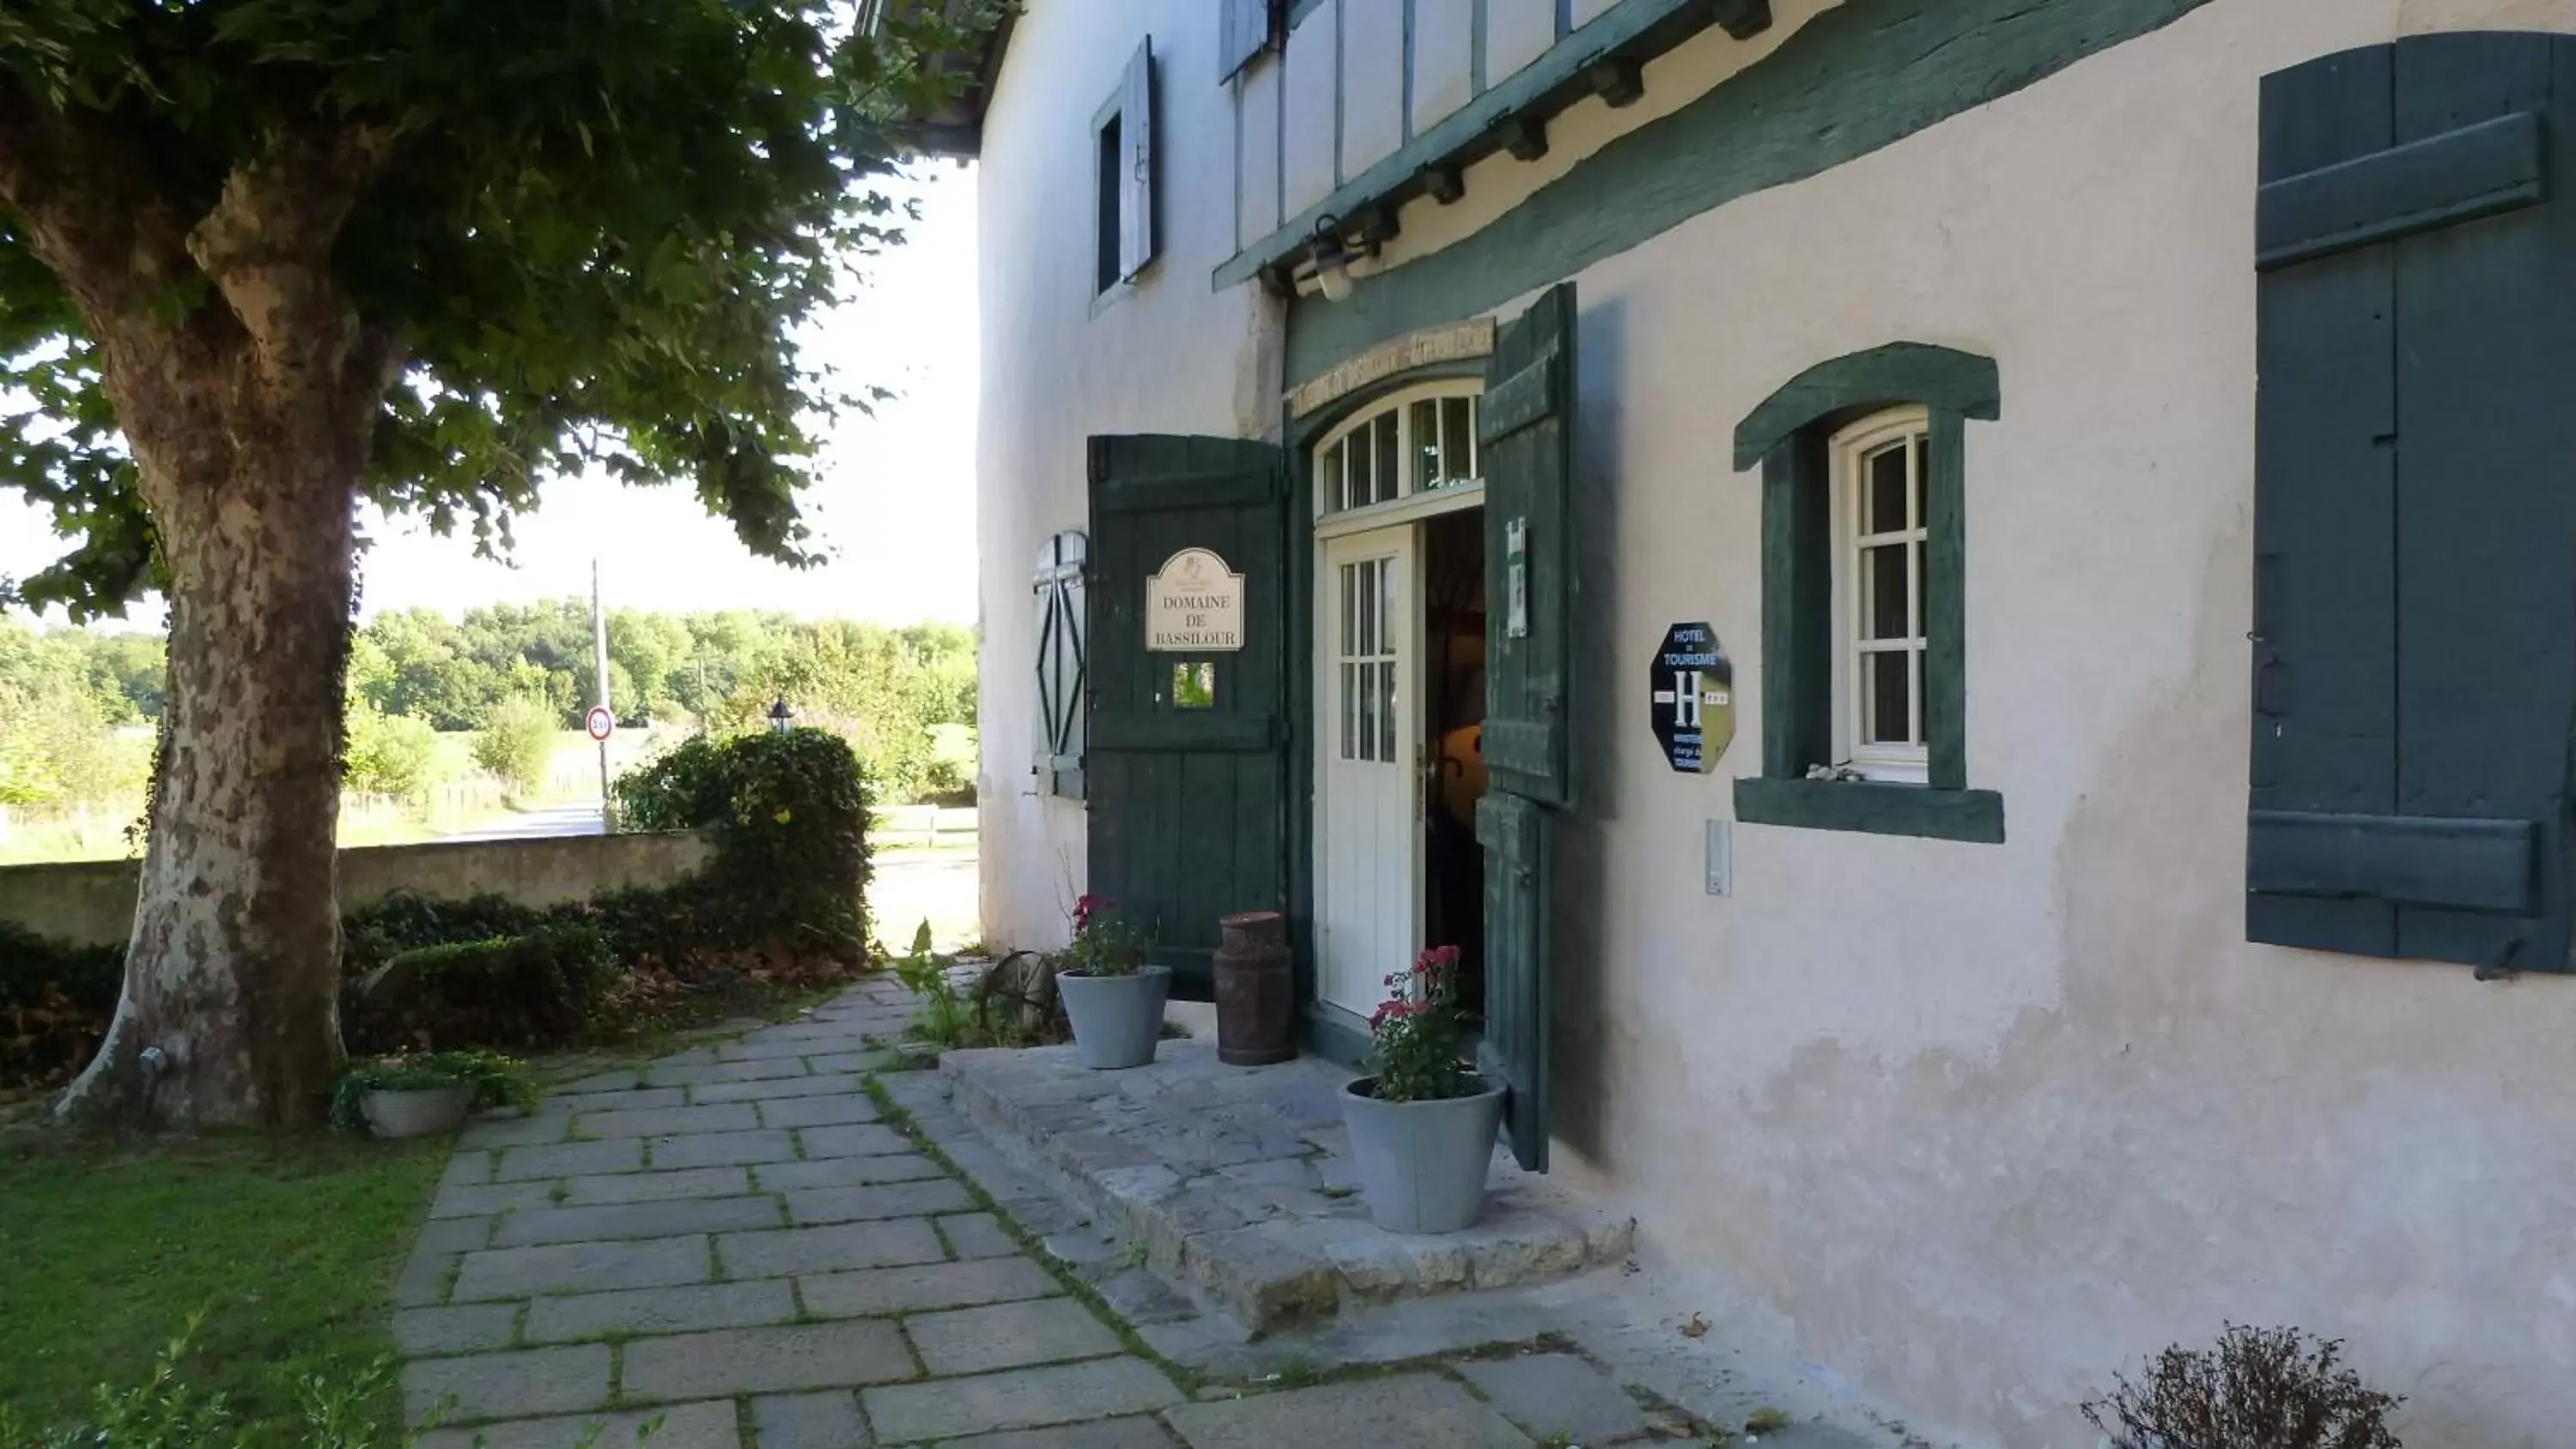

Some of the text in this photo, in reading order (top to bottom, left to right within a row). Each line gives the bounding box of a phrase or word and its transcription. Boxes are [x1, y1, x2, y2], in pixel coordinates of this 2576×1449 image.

[1163, 596, 1230, 609] DOMAINE
[1186, 615, 1206, 627] DE
[1156, 632, 1235, 646] BASSILOUR
[1664, 653, 1717, 665] TOURISME
[1674, 671, 1702, 727] H
